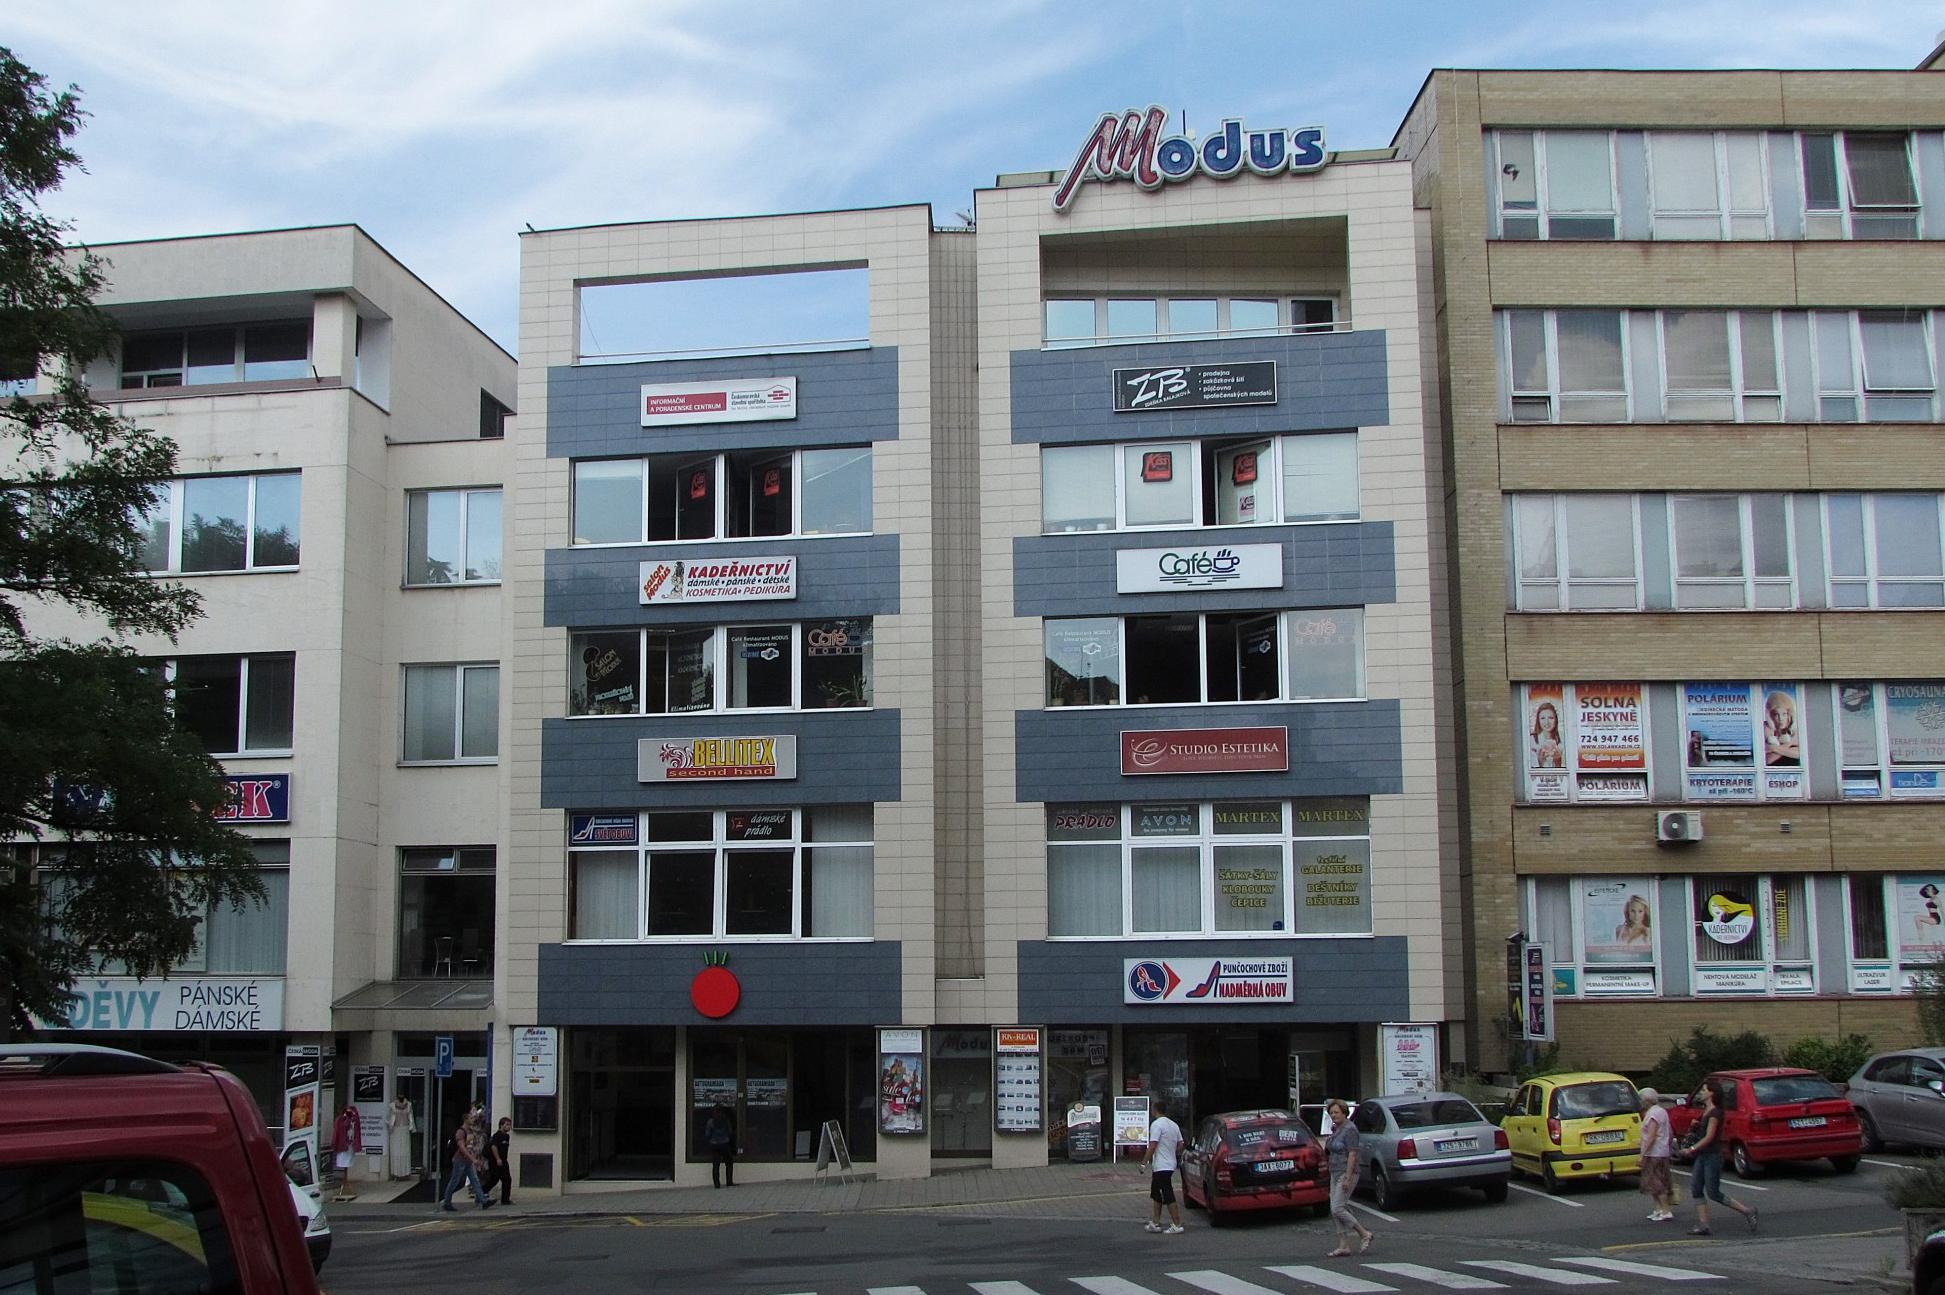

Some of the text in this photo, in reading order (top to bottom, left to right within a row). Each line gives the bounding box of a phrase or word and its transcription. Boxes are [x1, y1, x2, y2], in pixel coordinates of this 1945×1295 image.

[1054, 106, 1326, 211] Modus
[1203, 385, 1231, 393] půjčovna
[1203, 391, 1248, 400] společenských
[656, 404, 693, 412] PORADENSKÉ
[688, 560, 792, 578] KADEŘNICTVÍ
[1159, 551, 1212, 575] Café
[687, 575, 790, 587] dámské pánské dětské
[686, 587, 737, 597] KOSMETIKA
[1580, 709, 1637, 722] JESKYNĚ
[1580, 734, 1639, 743] 724 947 466
[693, 737, 776, 767] BELLITEX
[1170, 742, 1279, 755] STUDIO ESTETIKA
[669, 766, 773, 777] second hand
[1689, 779, 1798, 788] KRYOTERAPIE ESHOP
[750, 813, 787, 823] dámské
[1140, 814, 1191, 826] AVON
[1215, 812, 1280, 823] MARTEX
[1297, 809, 1364, 822] MARTEX
[744, 824, 772, 838] prádlo
[1301, 864, 1363, 875] GALANTERIE
[1222, 884, 1275, 894] KLOBOUKY
[1231, 895, 1266, 907] ČEPICE
[1306, 894, 1360, 906] BIŽUTERIE
[1223, 960, 1288, 973] PUNČOCHOVÉ ZBOŽÍ
[180, 980, 258, 1006] PÁNSKÉ
[1219, 979, 1287, 998] NADMĚRNÁ OBUV
[60, 979, 160, 1029] DĚVY
[175, 1005, 260, 1030] DÁMSKÉ
[440, 1042, 449, 1064] P
[1279, 1129, 1298, 1138] BEAT
